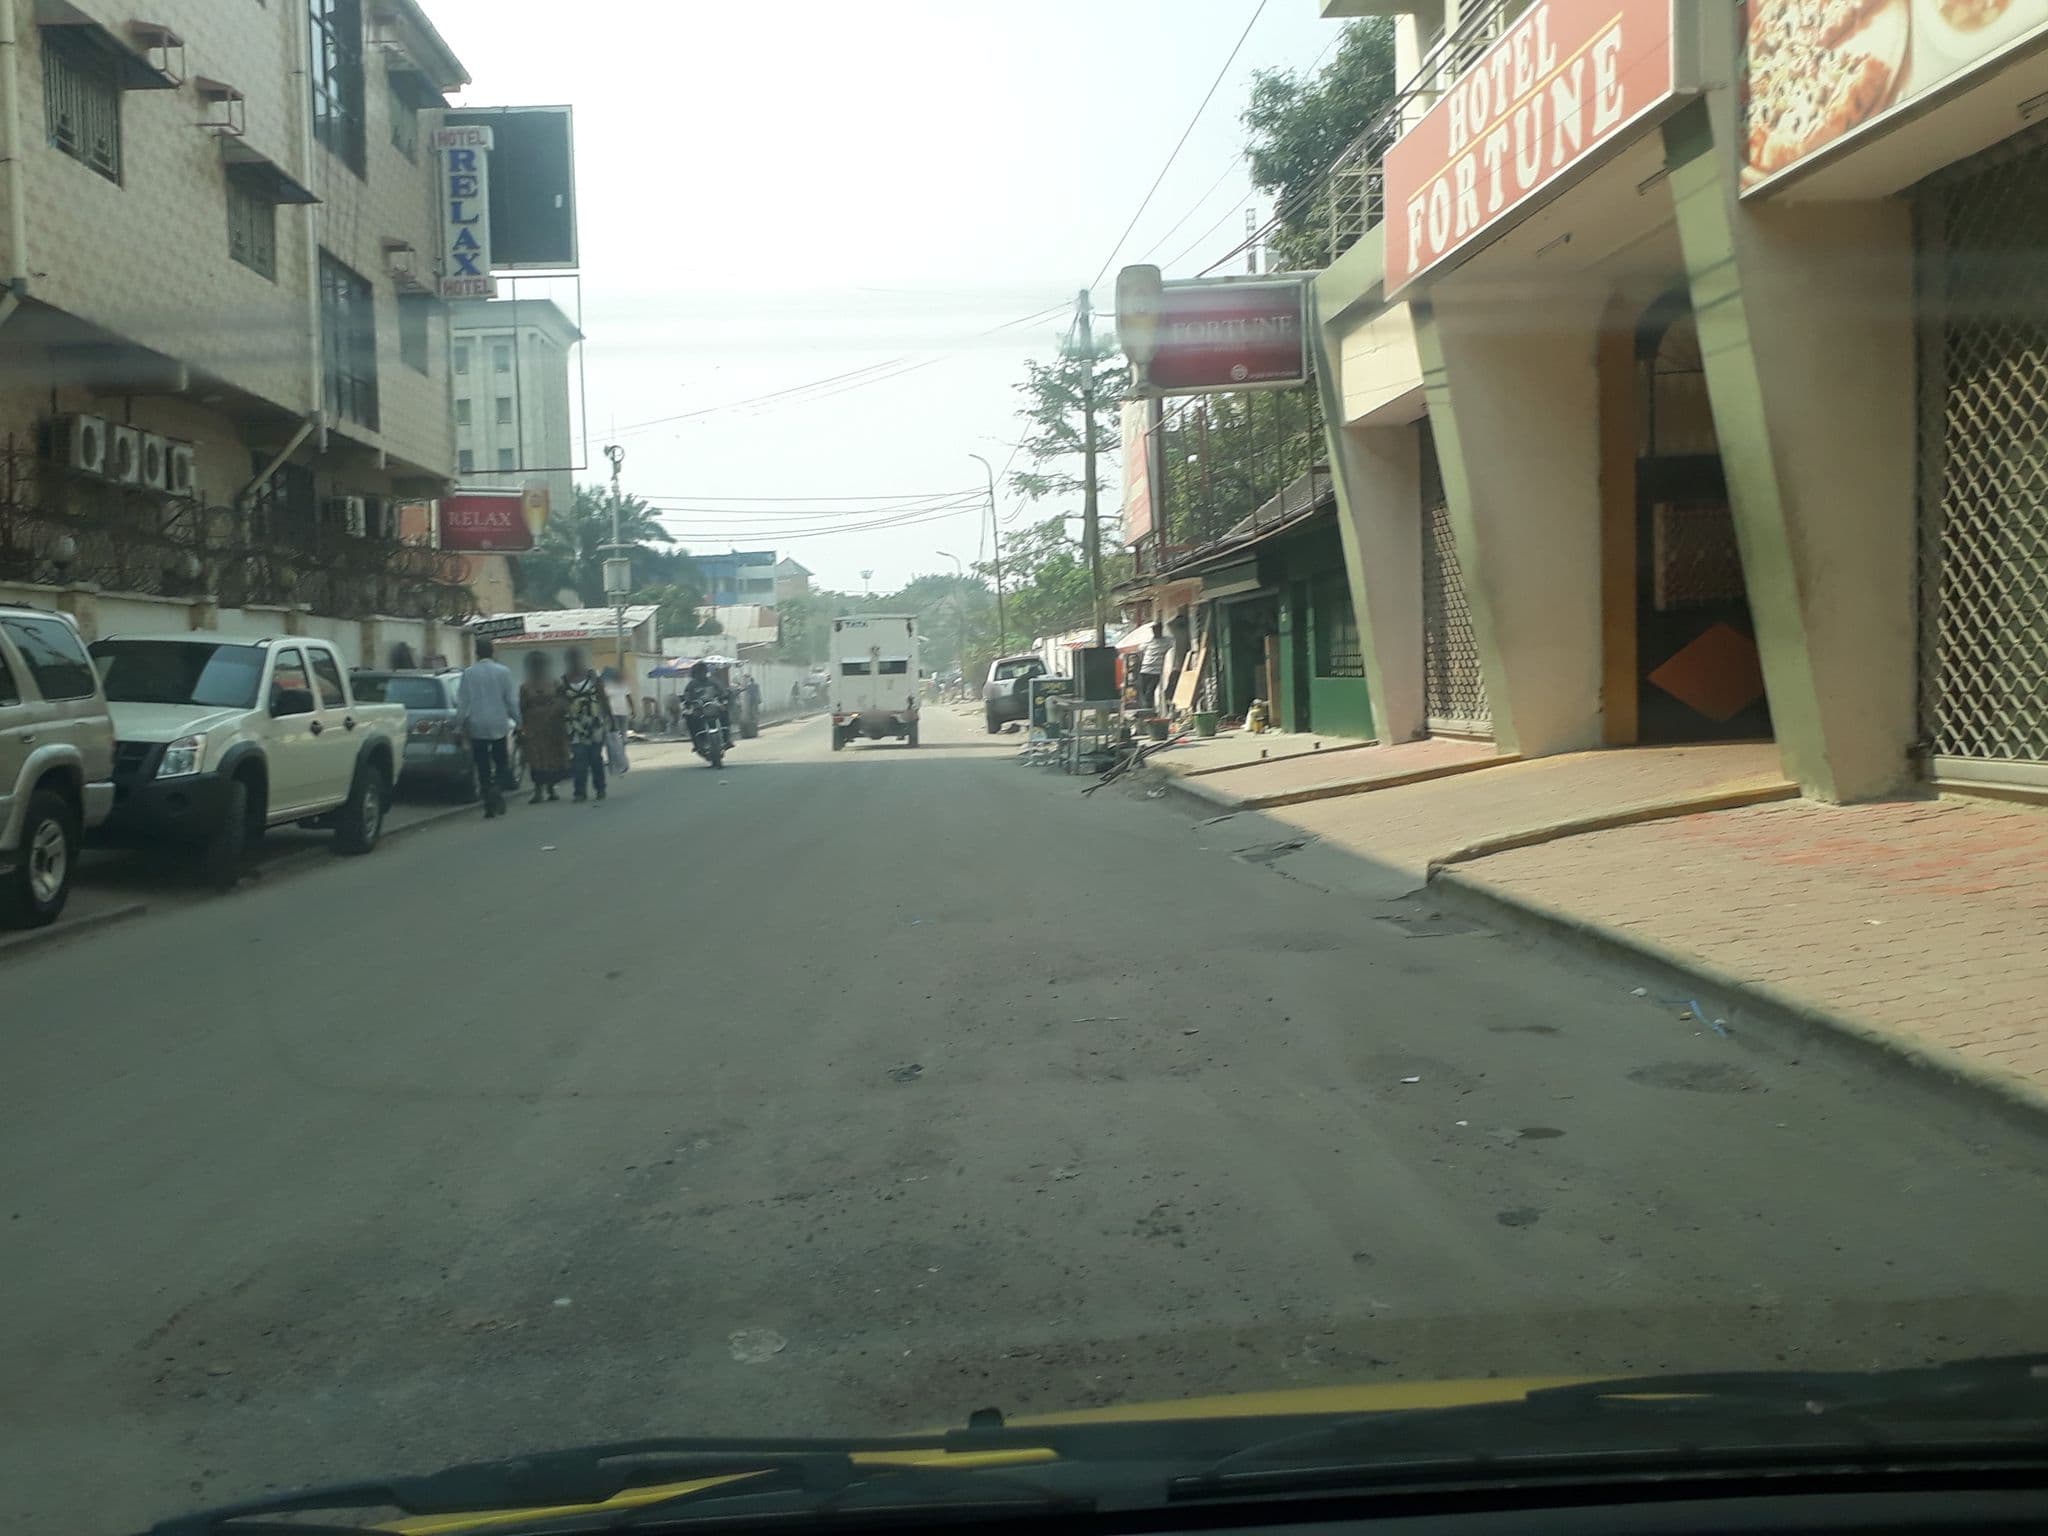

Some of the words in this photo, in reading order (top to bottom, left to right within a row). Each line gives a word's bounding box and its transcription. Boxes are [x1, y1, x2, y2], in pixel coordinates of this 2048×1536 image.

[1448, 4, 1557, 156] HOTEL
[437, 130, 487, 147] HOTEL
[1407, 24, 1624, 274] FORTUNE
[449, 149, 481, 276] RELAX
[442, 280, 493, 296] HOTEL
[448, 511, 512, 527] RELAX
